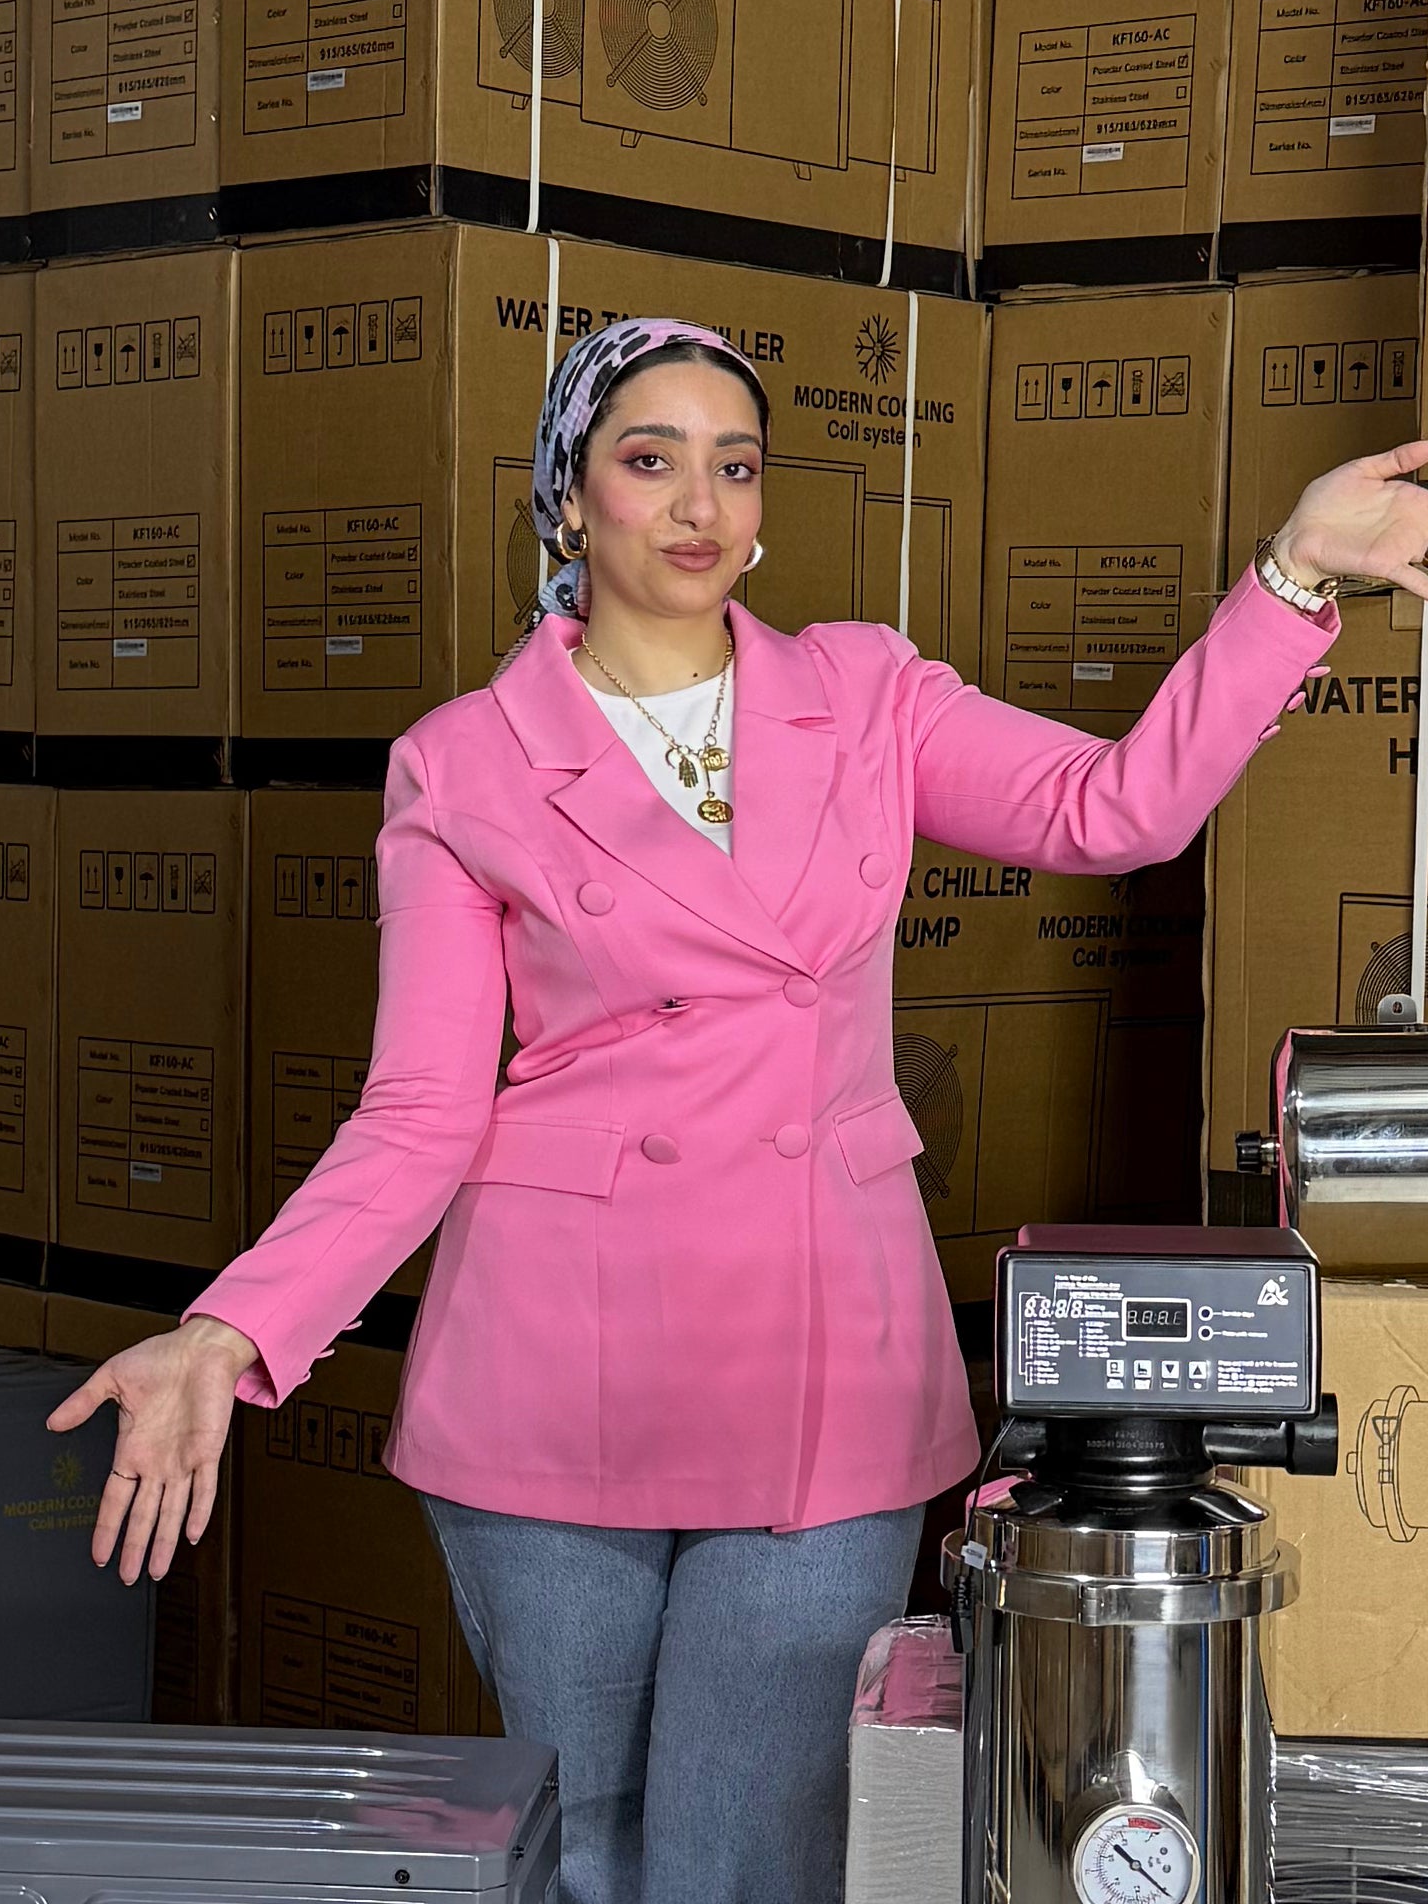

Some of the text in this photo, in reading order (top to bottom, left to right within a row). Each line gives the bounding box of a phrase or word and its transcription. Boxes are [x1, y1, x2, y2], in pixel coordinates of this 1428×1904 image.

[1112, 28, 1171, 46] KF160-AC
[793, 385, 873, 416] MODERN
[827, 420, 859, 442] Coil
[923, 867, 1032, 898] CHILLER
[1038, 915, 1122, 940] MODERN
[1072, 947, 1106, 968] Coil
